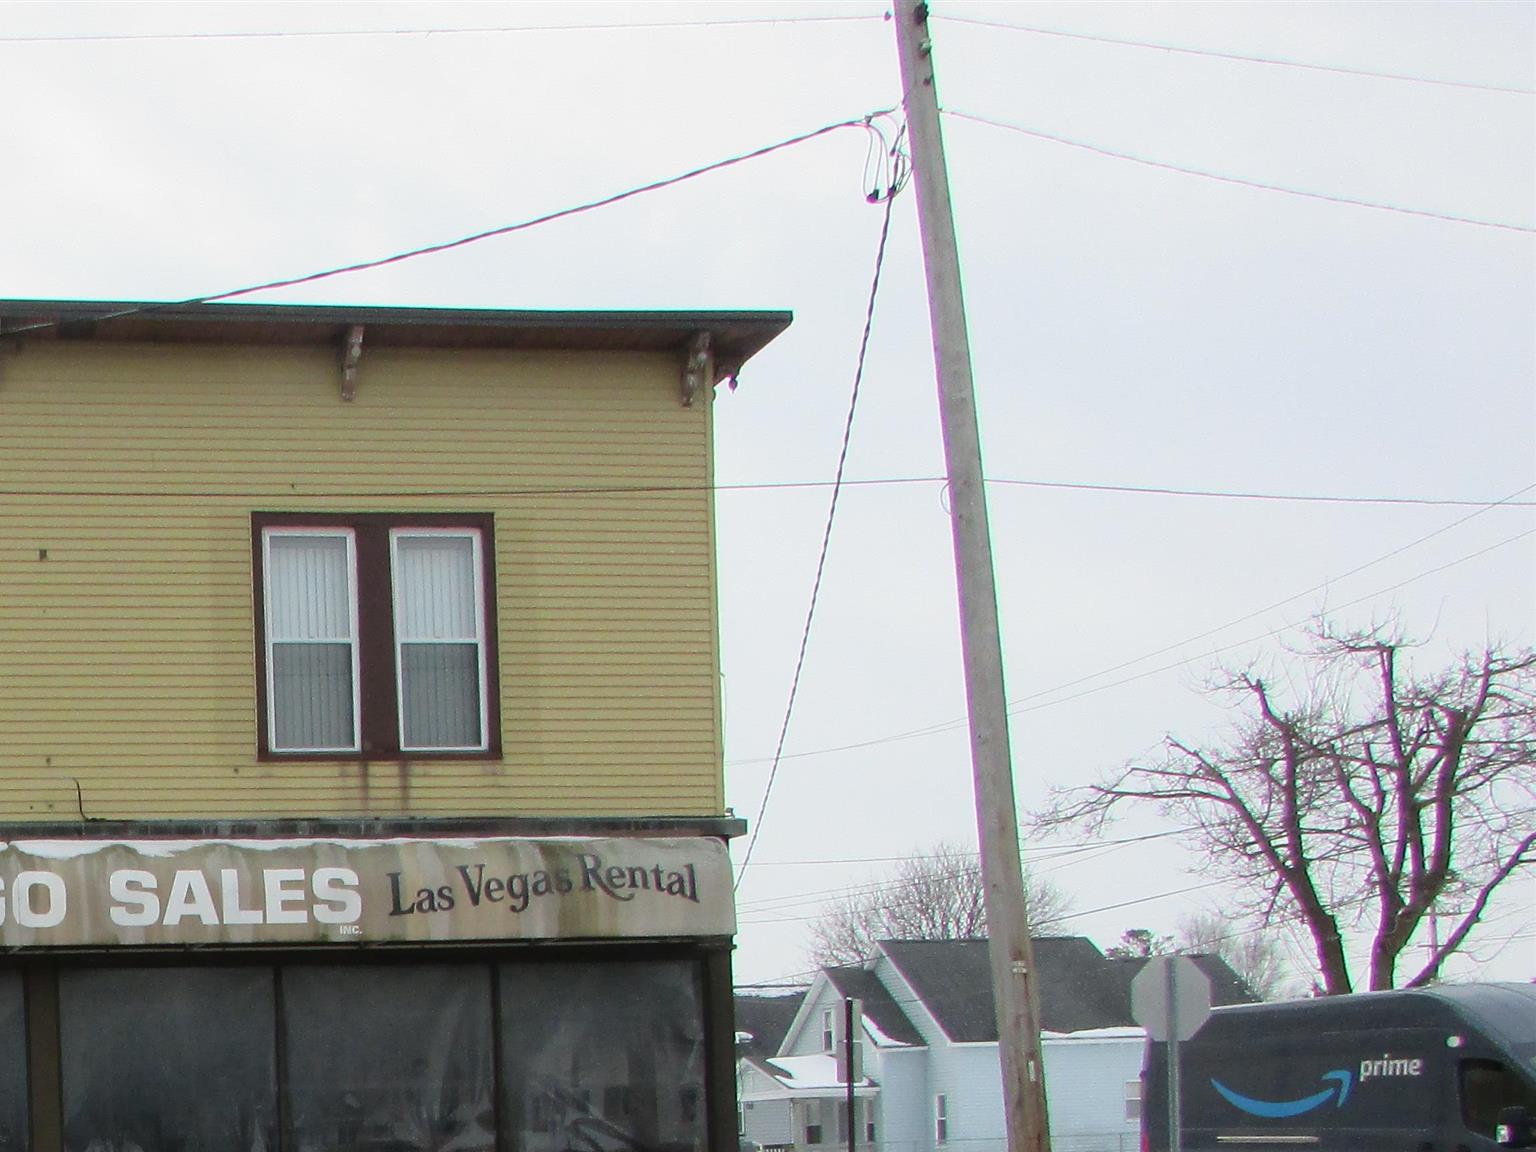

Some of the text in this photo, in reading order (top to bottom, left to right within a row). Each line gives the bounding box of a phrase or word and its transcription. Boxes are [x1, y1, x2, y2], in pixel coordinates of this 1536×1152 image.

[109, 867, 362, 926] SALES
[388, 853, 700, 917] Las Vegas Rental
[339, 925, 363, 935] INC.
[1360, 1053, 1421, 1081] prime
